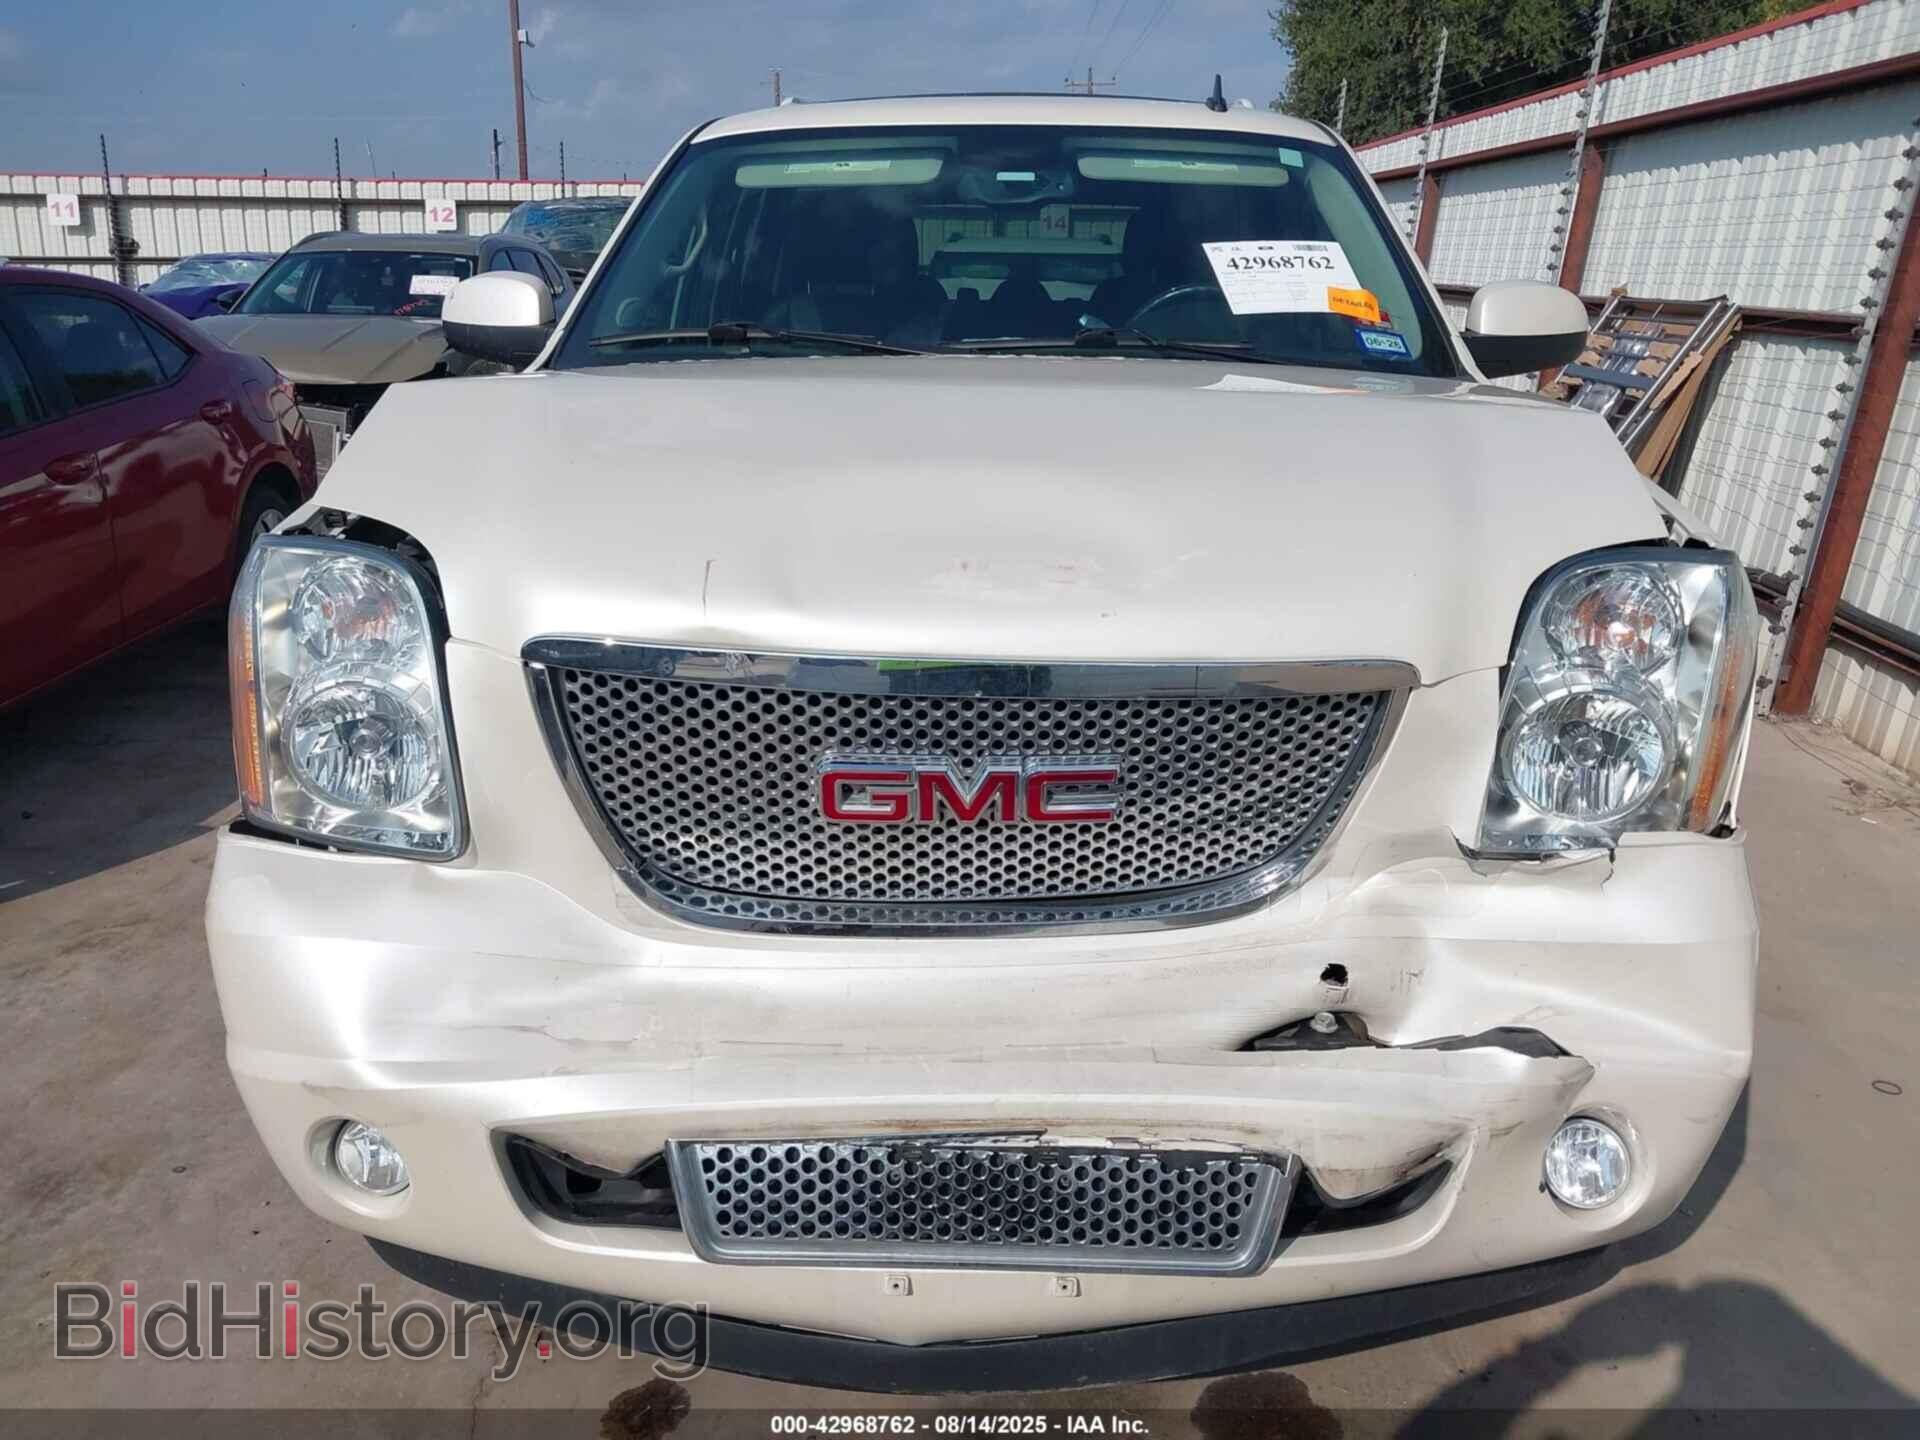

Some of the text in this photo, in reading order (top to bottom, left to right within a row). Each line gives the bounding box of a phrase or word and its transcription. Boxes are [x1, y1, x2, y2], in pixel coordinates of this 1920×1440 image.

[51, 201, 75, 218] 11
[430, 207, 454, 222] 12
[1226, 255, 1335, 270] 42968762
[818, 756, 1122, 824] GMC
